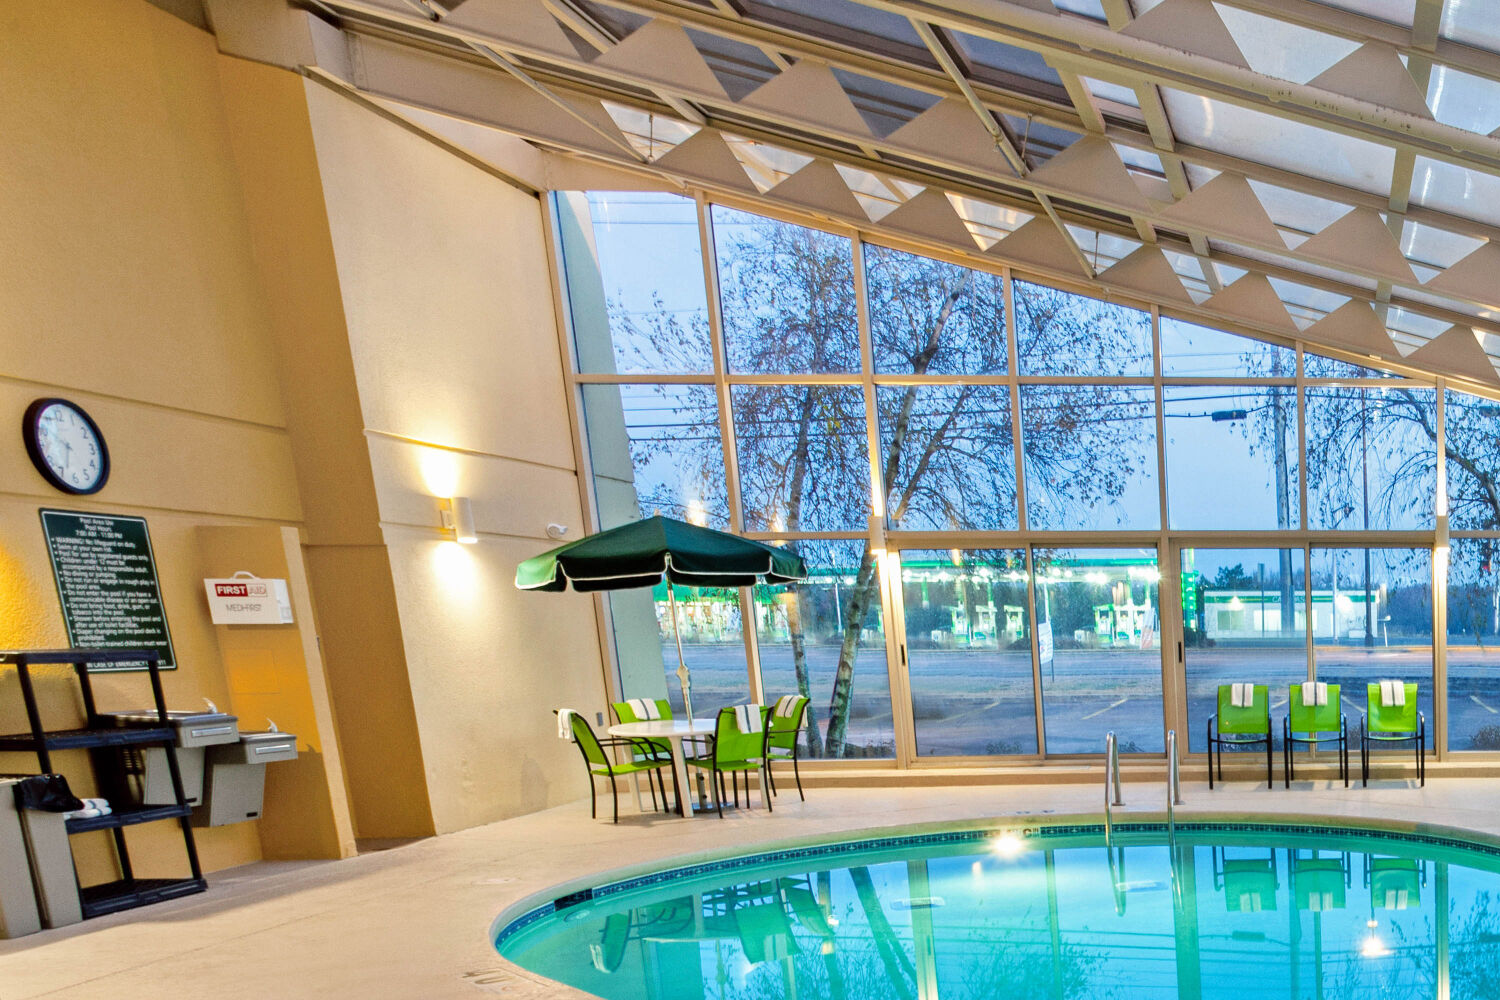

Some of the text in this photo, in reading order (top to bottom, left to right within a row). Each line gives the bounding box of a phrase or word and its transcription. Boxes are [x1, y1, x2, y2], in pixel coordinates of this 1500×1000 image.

[81, 426, 89, 439] 2
[88, 443, 96, 455] 3
[72, 472, 80, 484] 6
[83, 468, 90, 480] 5
[217, 586, 246, 594] FIRST
